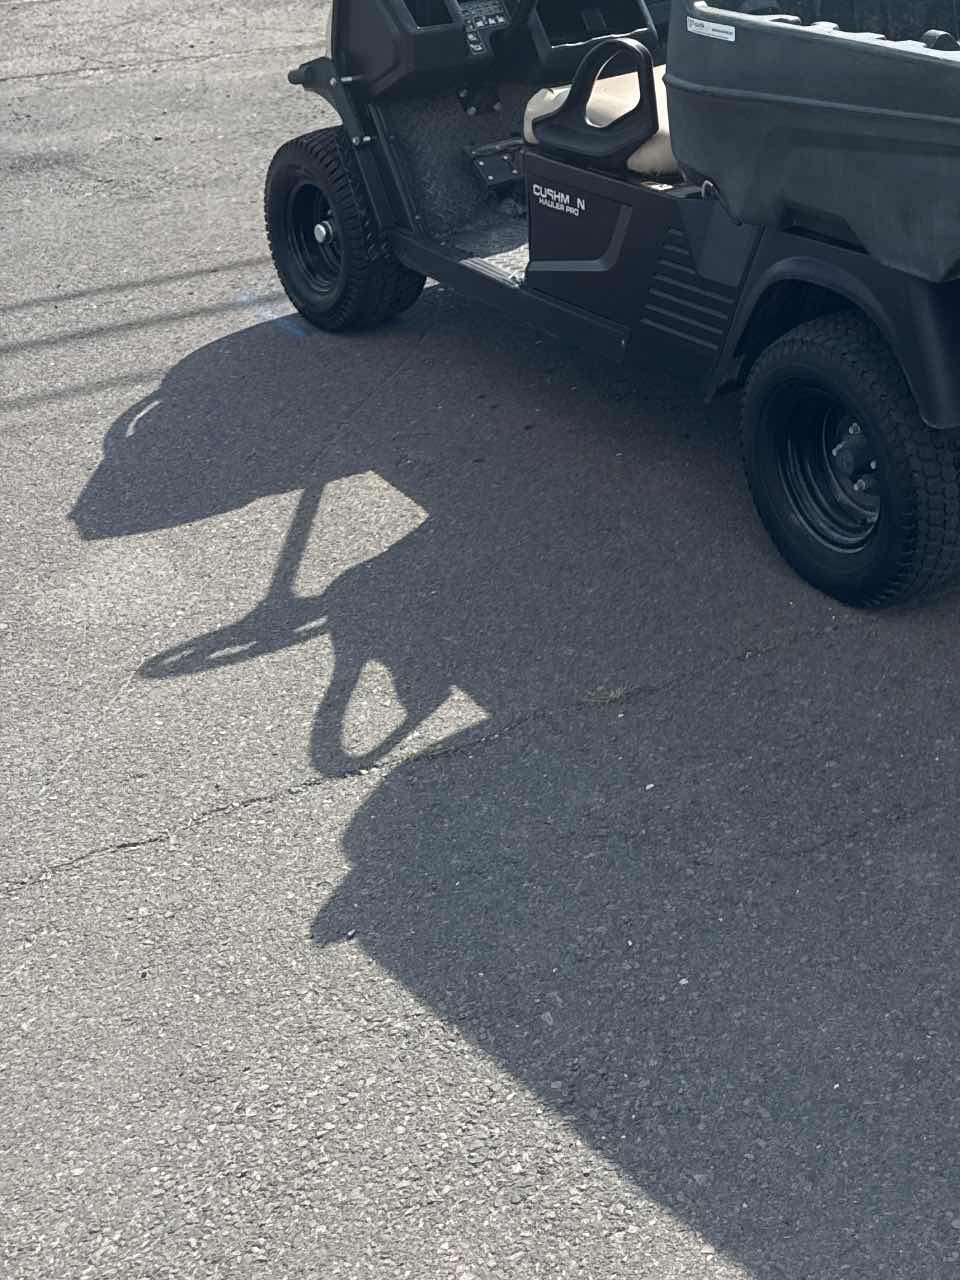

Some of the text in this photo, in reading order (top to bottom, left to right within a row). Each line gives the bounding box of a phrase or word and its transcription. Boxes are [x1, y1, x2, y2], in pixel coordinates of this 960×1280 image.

[533, 183, 586, 210] CUSHMN
[538, 197, 579, 216] HAULER PRO
